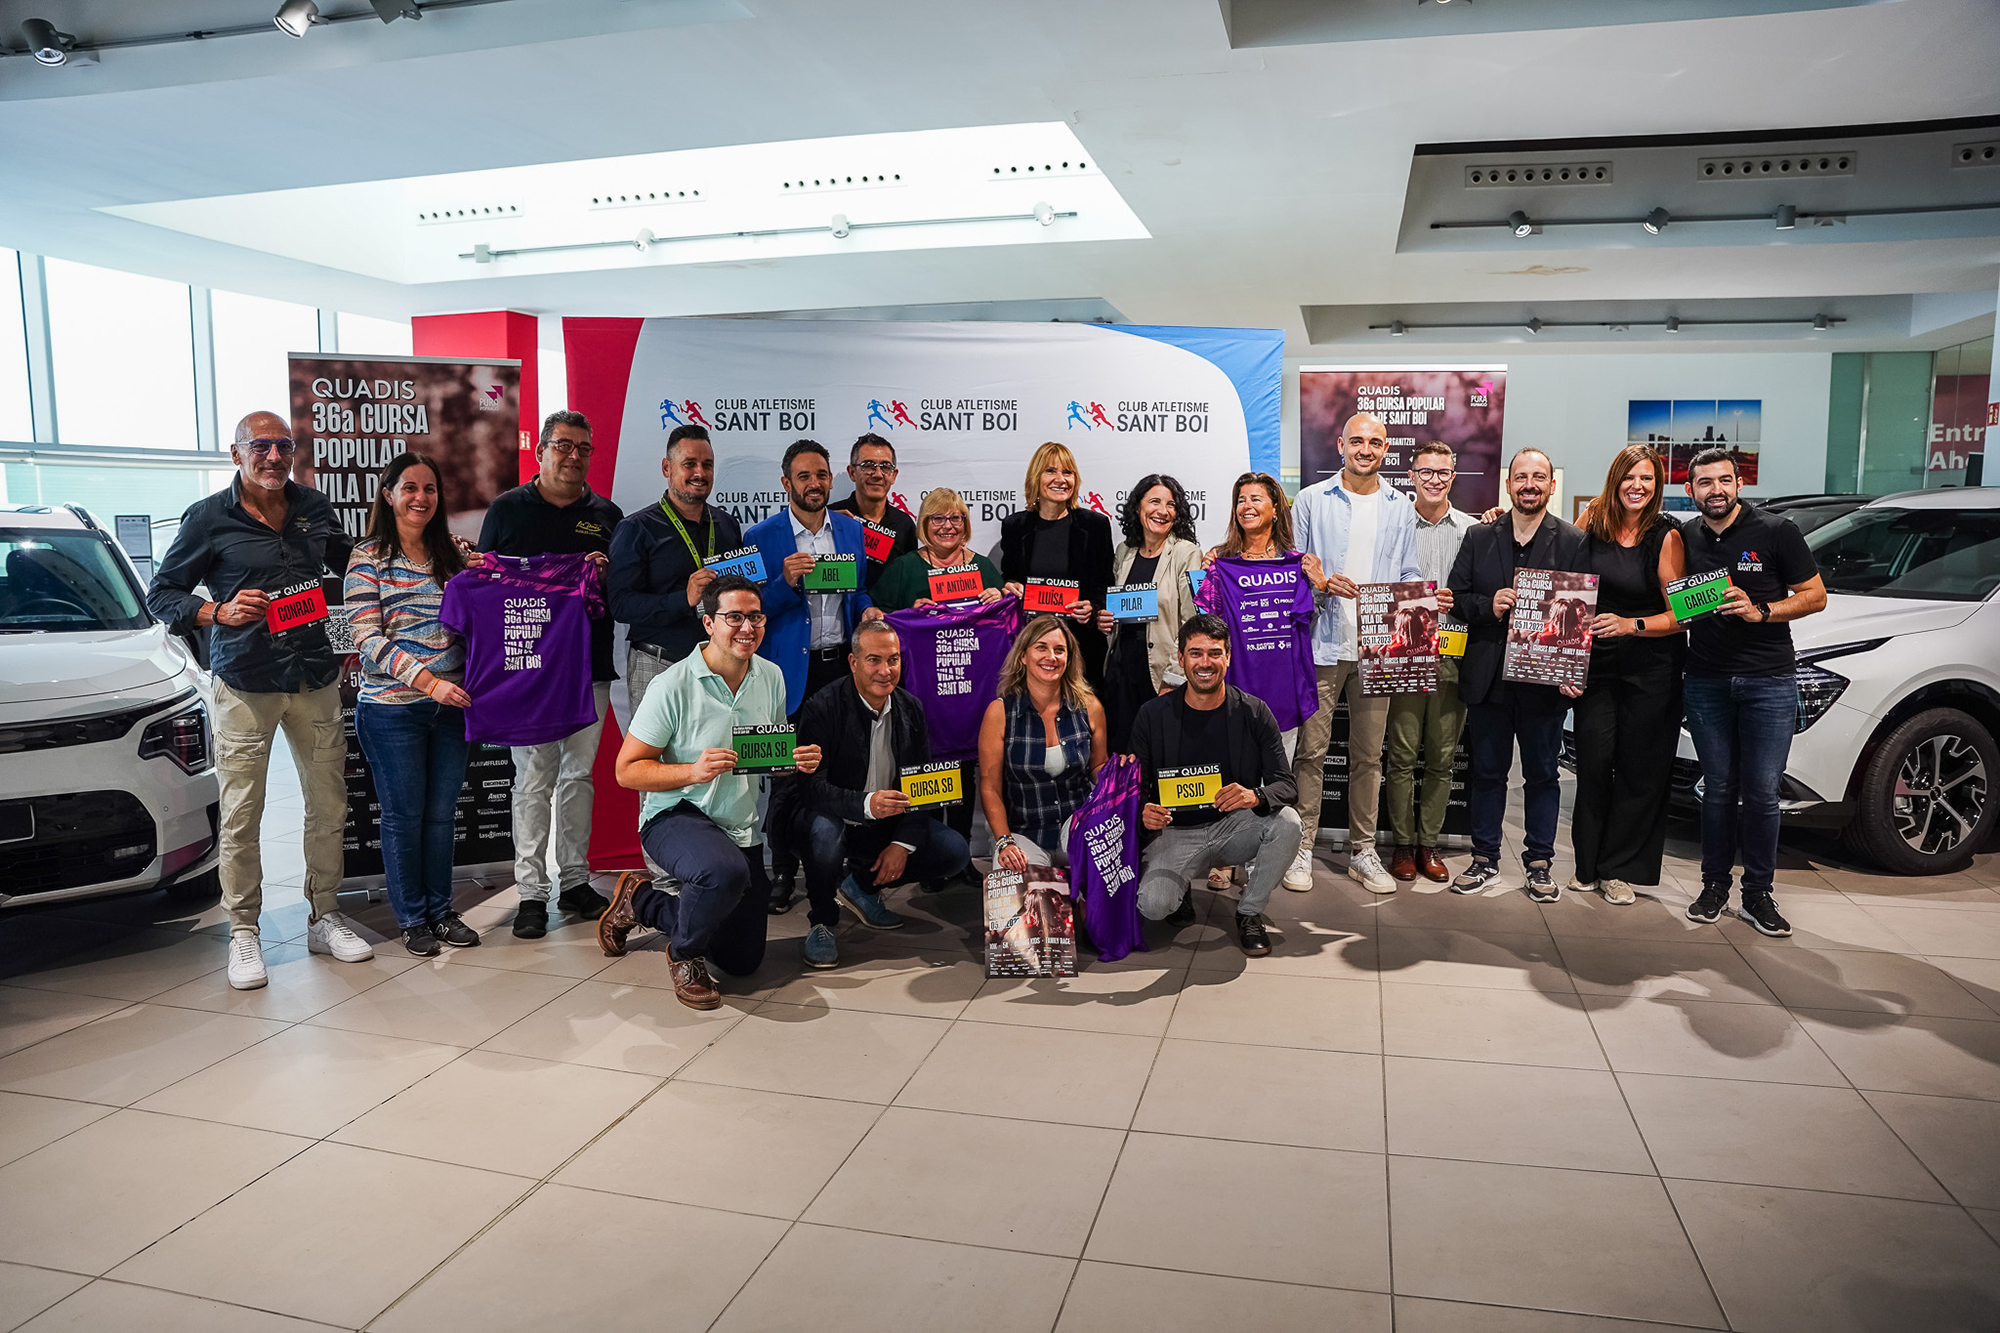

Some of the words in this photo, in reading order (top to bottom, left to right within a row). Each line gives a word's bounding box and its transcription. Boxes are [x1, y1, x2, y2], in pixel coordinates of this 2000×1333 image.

[311, 377, 415, 400] QUADIS
[1357, 385, 1400, 396] QUADIS
[715, 399, 748, 410] CLUB
[751, 398, 815, 410] ATLETISME
[920, 399, 952, 410] CLUB
[956, 399, 1018, 411] ATLETISME
[1118, 401, 1148, 412] CLUB
[1151, 402, 1209, 413] ATLETISME
[1357, 397, 1375, 410] 36a
[1376, 397, 1405, 410] CURSA
[1406, 397, 1445, 411] POPULAR
[312, 402, 355, 433] 36a
[360, 403, 429, 434] CURSA
[714, 412, 770, 431] SANT
[779, 412, 816, 431] BOI
[920, 412, 976, 431] SANT
[982, 413, 1018, 431] BOI
[1117, 415, 1168, 432] SANT
[1175, 415, 1209, 432] BOI
[1389, 411, 1411, 424] SANT
[1412, 411, 1427, 424] BOI
[314, 473, 360, 502] VILA
[716, 492, 748, 503] CLUB
[752, 492, 790, 503] ATLETI
[867, 521, 897, 538] QUADIS
[723, 544, 758, 560] QUADIS
[824, 553, 855, 561] QUADIS
[744, 561, 757, 576] SB
[822, 568, 840, 582] ABEL
[947, 563, 979, 574] QUADIS
[1519, 571, 1550, 580] QUADIS
[946, 577, 977, 593] ANTÒNIA
[1046, 578, 1079, 588] QUADIS
[1238, 571, 1297, 588] QUADIS
[1517, 579, 1531, 588] 36a
[1531, 579, 1553, 591] CURSA
[1687, 569, 1725, 587] QUADIS
[283, 578, 320, 596] QUADIS
[1125, 582, 1157, 592] QUADIS
[1360, 586, 1390, 594] QUADIS
[1360, 594, 1373, 603] 36a
[1374, 592, 1394, 603] CURSA
[1517, 589, 1545, 600] POPULAR
[1684, 587, 1719, 610] CARLES
[277, 597, 316, 622] CONRAD
[504, 597, 547, 608] QUADIS
[1120, 597, 1142, 611] PILAR
[1360, 604, 1388, 614] POPULAR
[1516, 599, 1529, 609] VILA
[1530, 600, 1538, 610] DE
[523, 608, 551, 623] CURSA
[1361, 614, 1374, 624] VILA
[1375, 614, 1383, 624] DE
[1514, 609, 1530, 619] SANT
[1531, 610, 1542, 620] BOI
[504, 625, 542, 640] POPULAR
[936, 628, 974, 639] QUADIS
[1361, 625, 1377, 635] SANT
[1379, 624, 1388, 633] BOI
[953, 638, 980, 652] CURSA
[504, 656, 524, 671] SANT
[526, 654, 542, 669] BOI
[936, 652, 971, 667] POPULAR
[937, 682, 957, 696] SANT
[958, 680, 972, 694] BOI
[756, 723, 795, 734] QUADIS
[741, 742, 772, 759] CURSA
[775, 741, 787, 757] SB
[923, 760, 960, 773] QUADIS
[1181, 765, 1220, 776] QUADIS
[910, 779, 940, 798] CURSA
[941, 777, 953, 793] SB
[1177, 782, 1205, 799] PSSJD
[1084, 813, 1121, 841] QUADIS
[988, 879, 1000, 889] 36a
[1001, 875, 1024, 887] CURSA
[988, 885, 1017, 899] POPULAR
